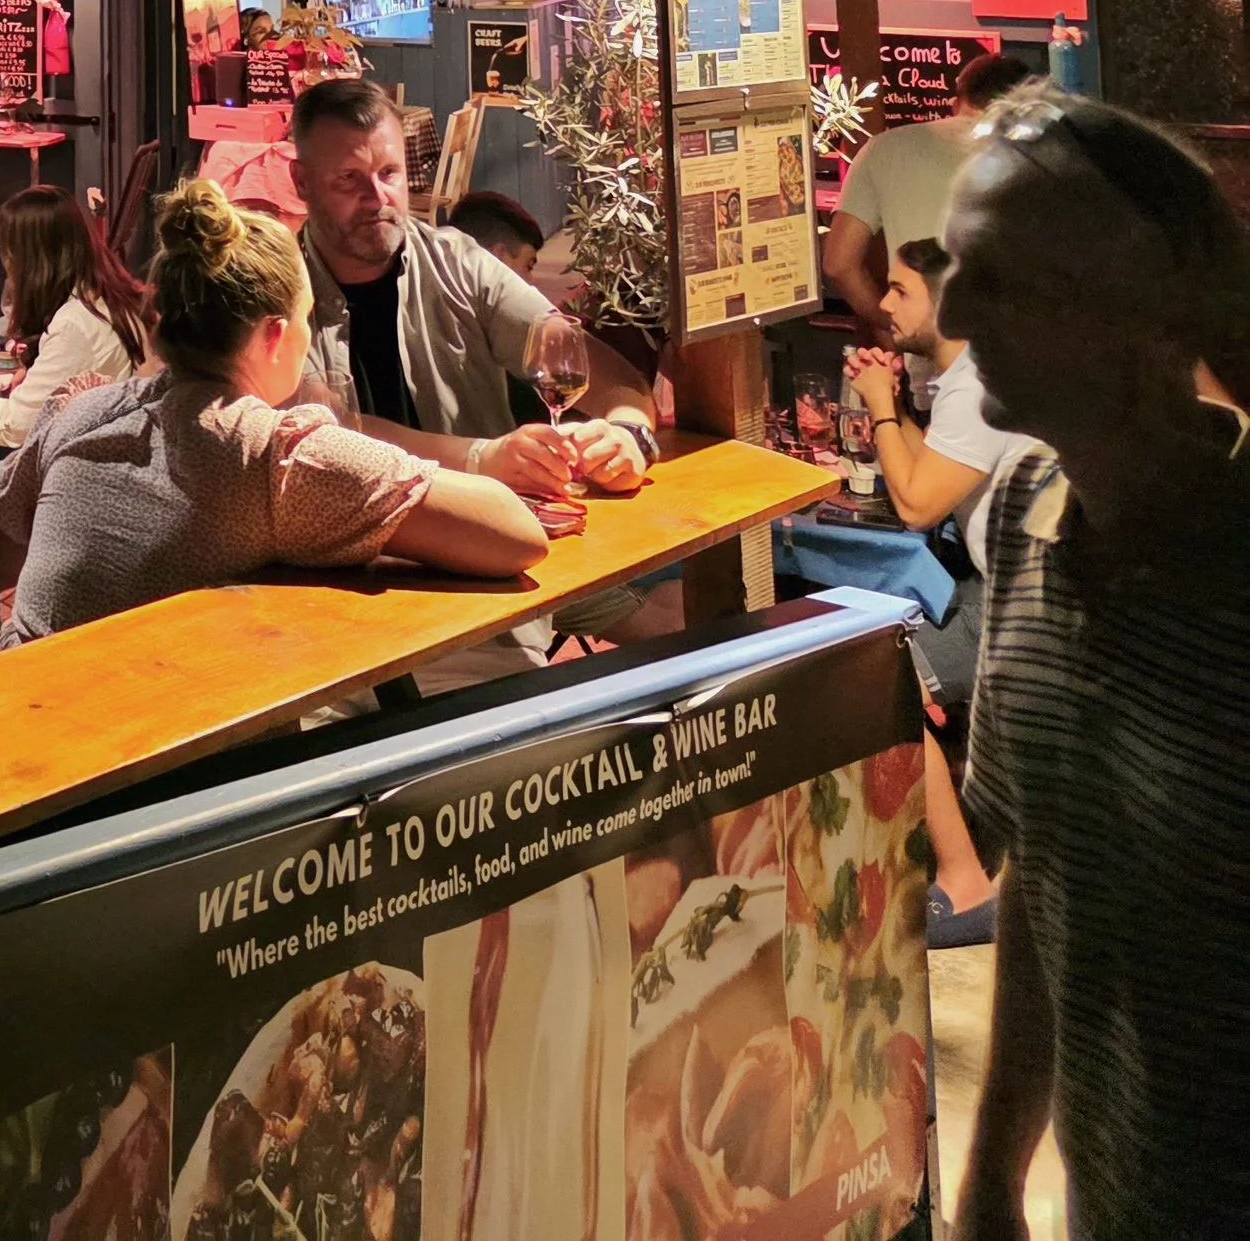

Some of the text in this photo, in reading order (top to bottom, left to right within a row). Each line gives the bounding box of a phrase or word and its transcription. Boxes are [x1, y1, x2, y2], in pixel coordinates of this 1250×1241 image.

[474, 29, 502, 38] CRAFT
[898, 67, 950, 91] Cloud
[199, 693, 778, 934] WELCOME TO OUR COCKTAIL & WINE BAR
[216, 750, 756, 979] "Where the best cocktails, food, and wine come together in town!"
[836, 1144, 892, 1212] PINSA
